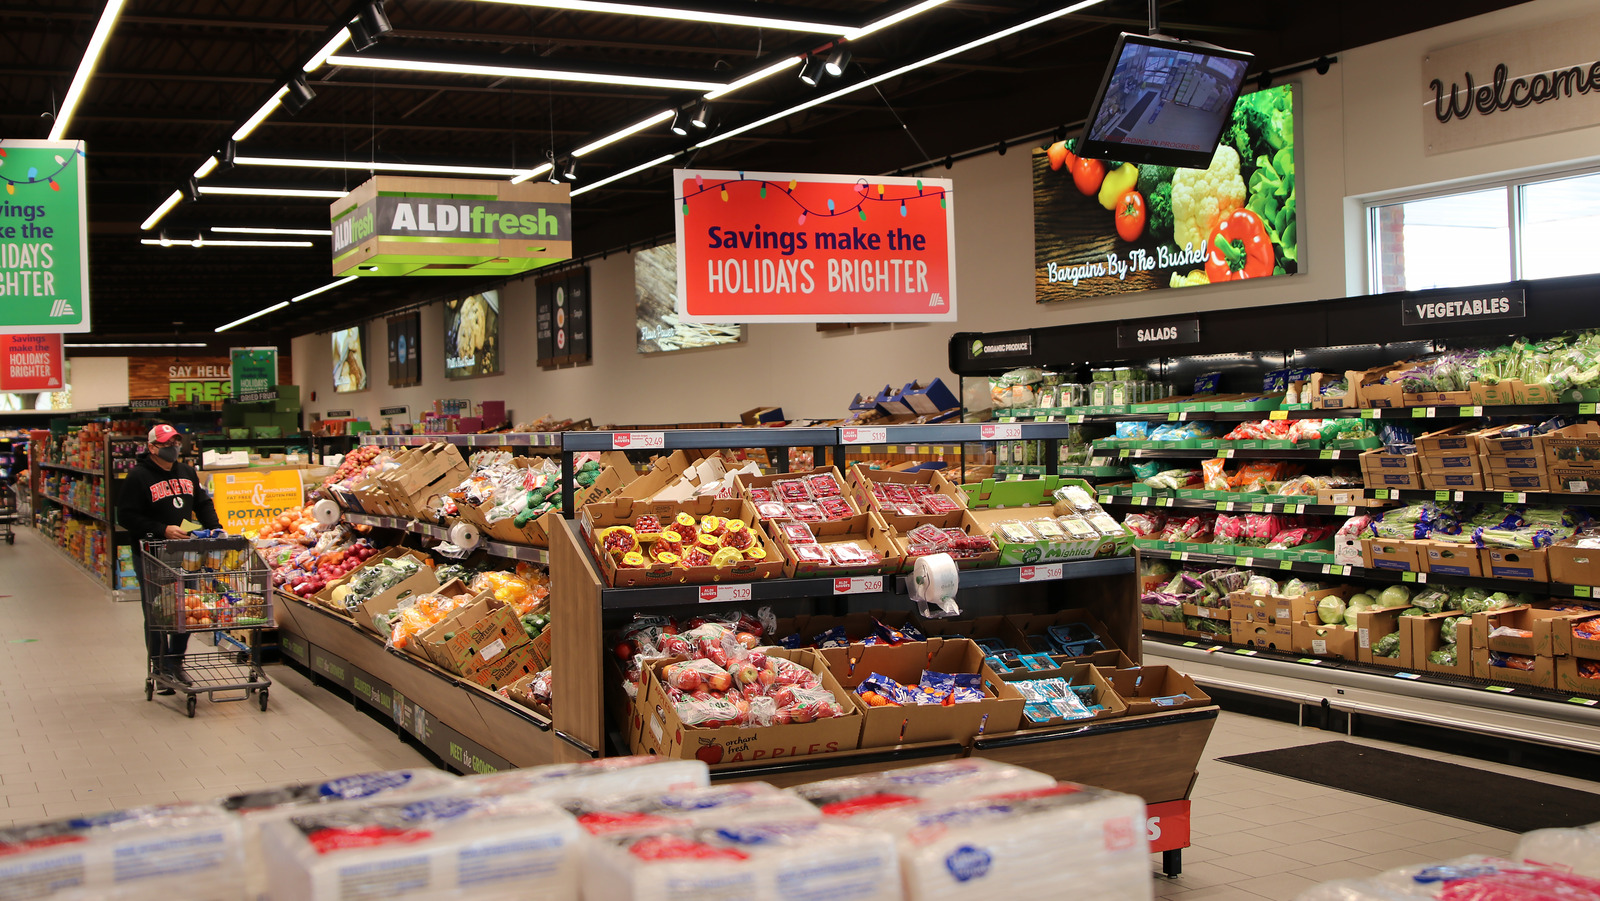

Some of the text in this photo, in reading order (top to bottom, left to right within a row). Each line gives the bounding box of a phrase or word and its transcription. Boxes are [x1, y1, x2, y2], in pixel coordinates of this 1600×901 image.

[1429, 63, 1600, 123] Welcome
[1160, 141, 1201, 151] PROGRESS
[391, 203, 559, 236] ALDIfresh
[21, 222, 54, 239] the
[334, 207, 374, 253] ALDIfresh
[708, 223, 926, 255] Savings make the
[0, 243, 54, 269] IDAYS
[1047, 240, 1210, 286] Bargains By The Bushel
[708, 258, 929, 294] HOLIDAYS BRIGHTER
[1416, 297, 1510, 319] VEGETABLES
[12, 335, 46, 344] Savings
[1137, 326, 1178, 342] SALADS
[983, 342, 1028, 353] ORGANIC PRODUCE
[9, 352, 50, 365] HOLIDAYS
[10, 365, 52, 378] BRIGHTER
[168, 365, 192, 377] SAY
[240, 391, 277, 402] DRIED FRUIT
[644, 437, 663, 446] $2.49
[228, 518, 255, 527] HAVE
[1044, 548, 1092, 559] Mighties
[1047, 568, 1062, 577] $1.69
[864, 580, 882, 590] $2.69
[733, 588, 751, 598] $1.29
[725, 733, 758, 747] orchard
[450, 741, 463, 762] MEET
[463, 750, 472, 768] the
[727, 743, 749, 755] fresh
